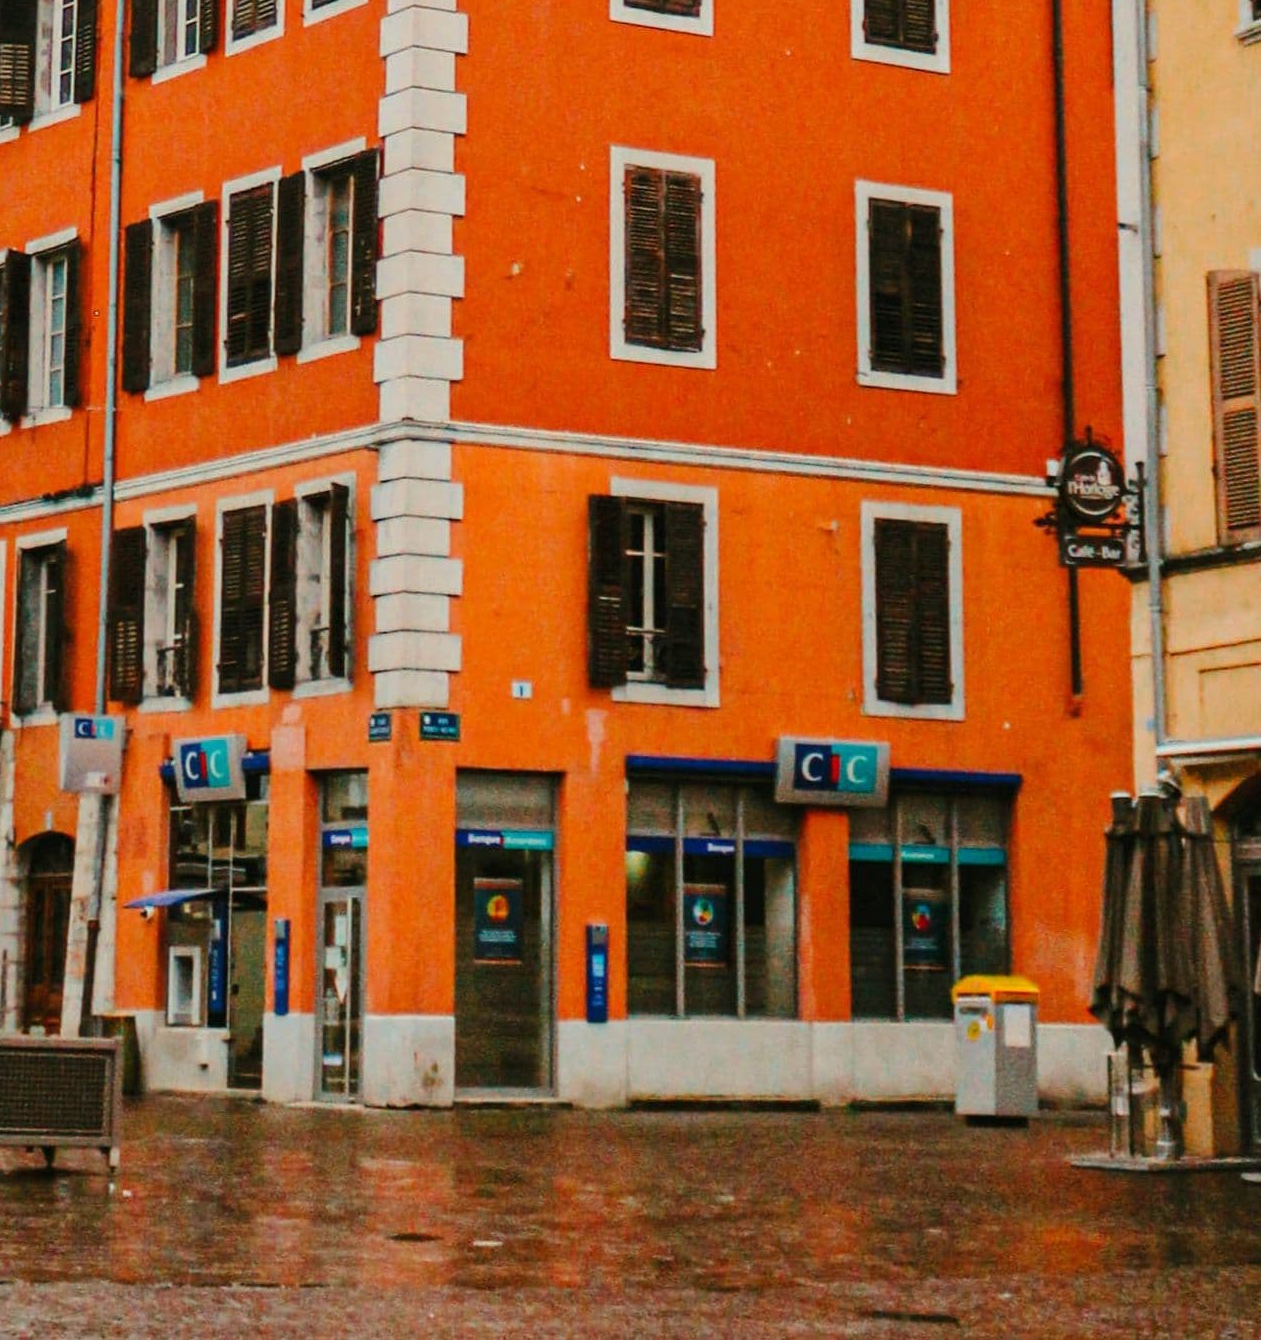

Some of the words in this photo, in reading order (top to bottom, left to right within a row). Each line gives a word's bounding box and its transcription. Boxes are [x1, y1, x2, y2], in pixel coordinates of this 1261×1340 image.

[77, 721, 108, 737] CIC
[185, 749, 224, 782] CIC
[800, 752, 868, 785] CIC
